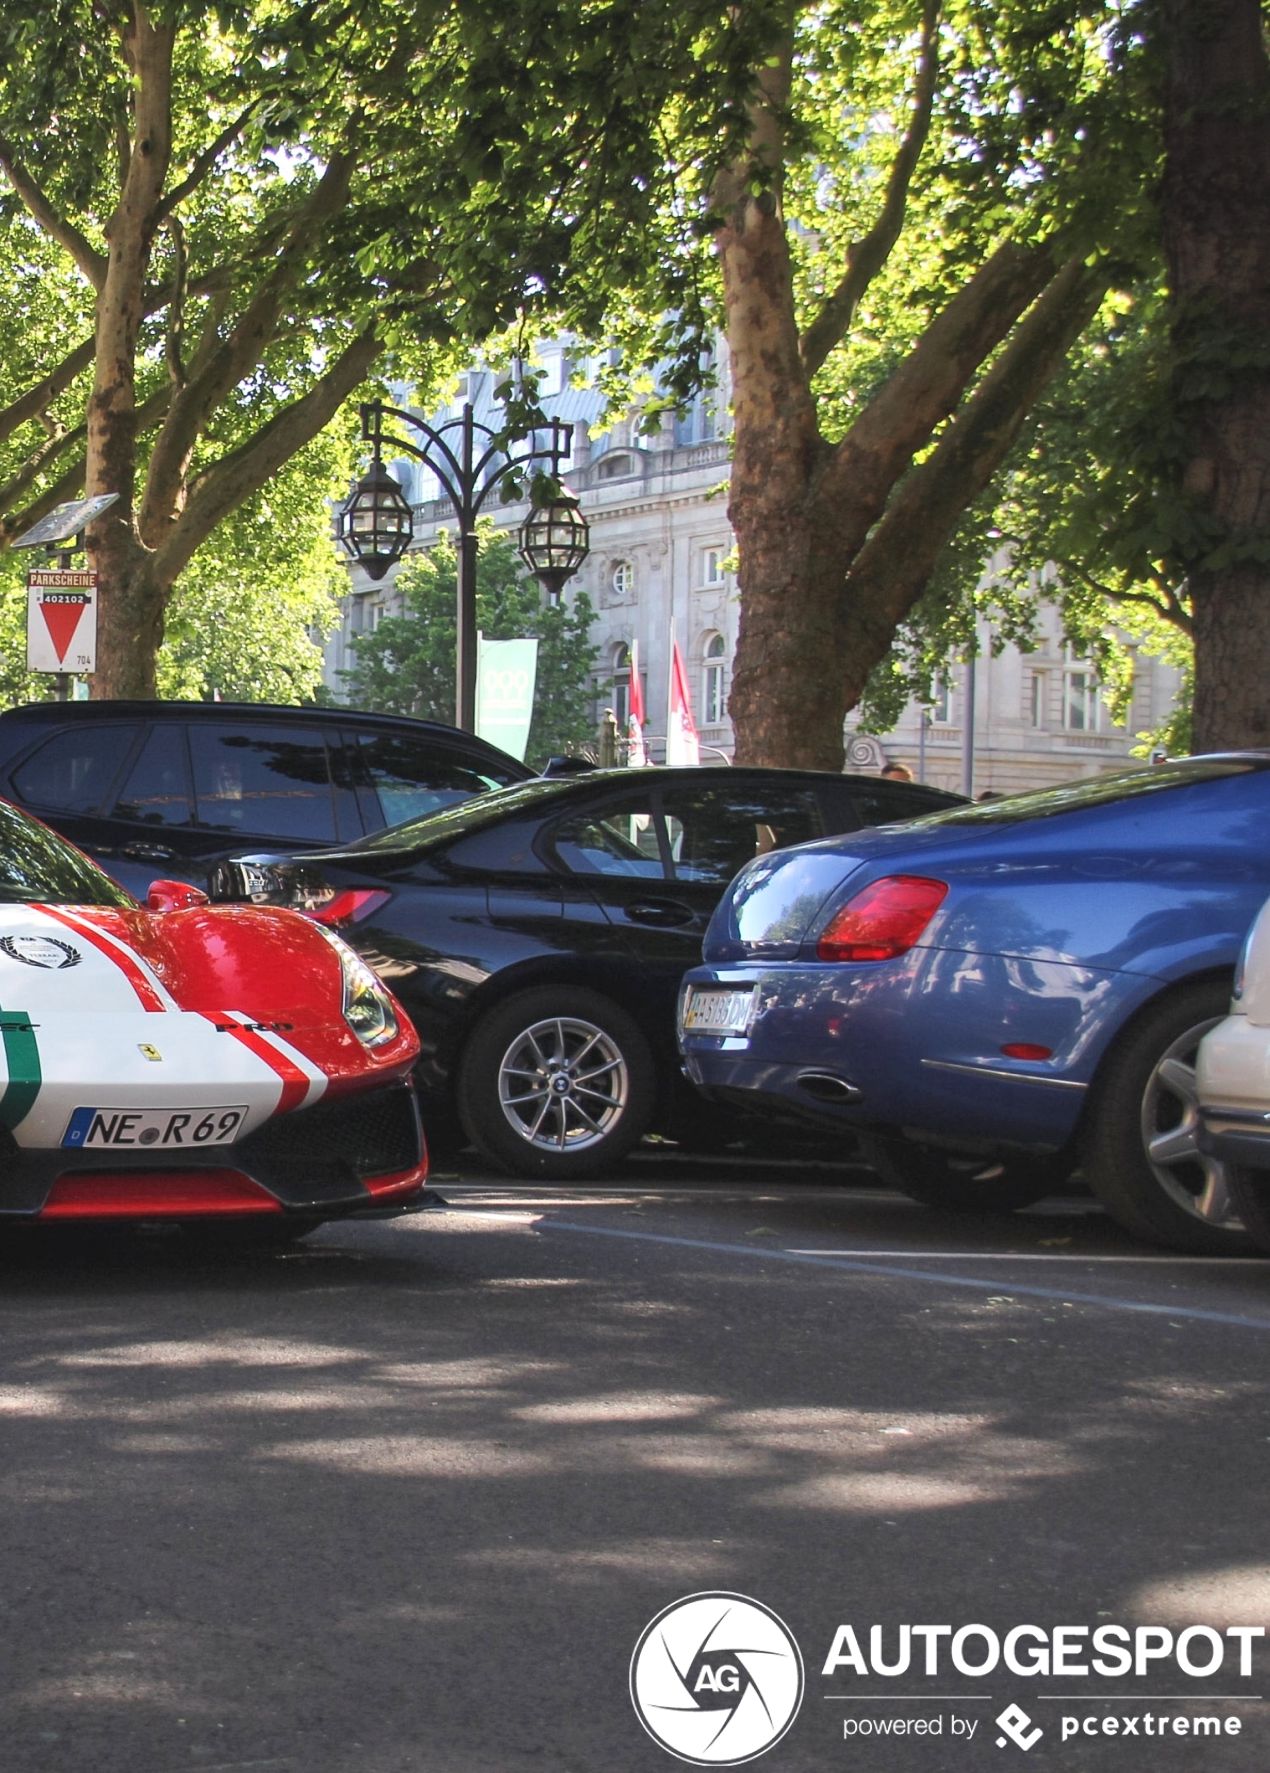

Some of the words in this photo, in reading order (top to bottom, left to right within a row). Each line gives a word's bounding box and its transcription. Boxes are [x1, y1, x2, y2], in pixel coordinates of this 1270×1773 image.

[30, 574, 95, 586] PARKSCHEINE
[44, 595, 84, 603] 402102
[77, 655, 91, 665] 704
[215, 1022, 294, 1032] PRO
[86, 1113, 143, 1143] NE
